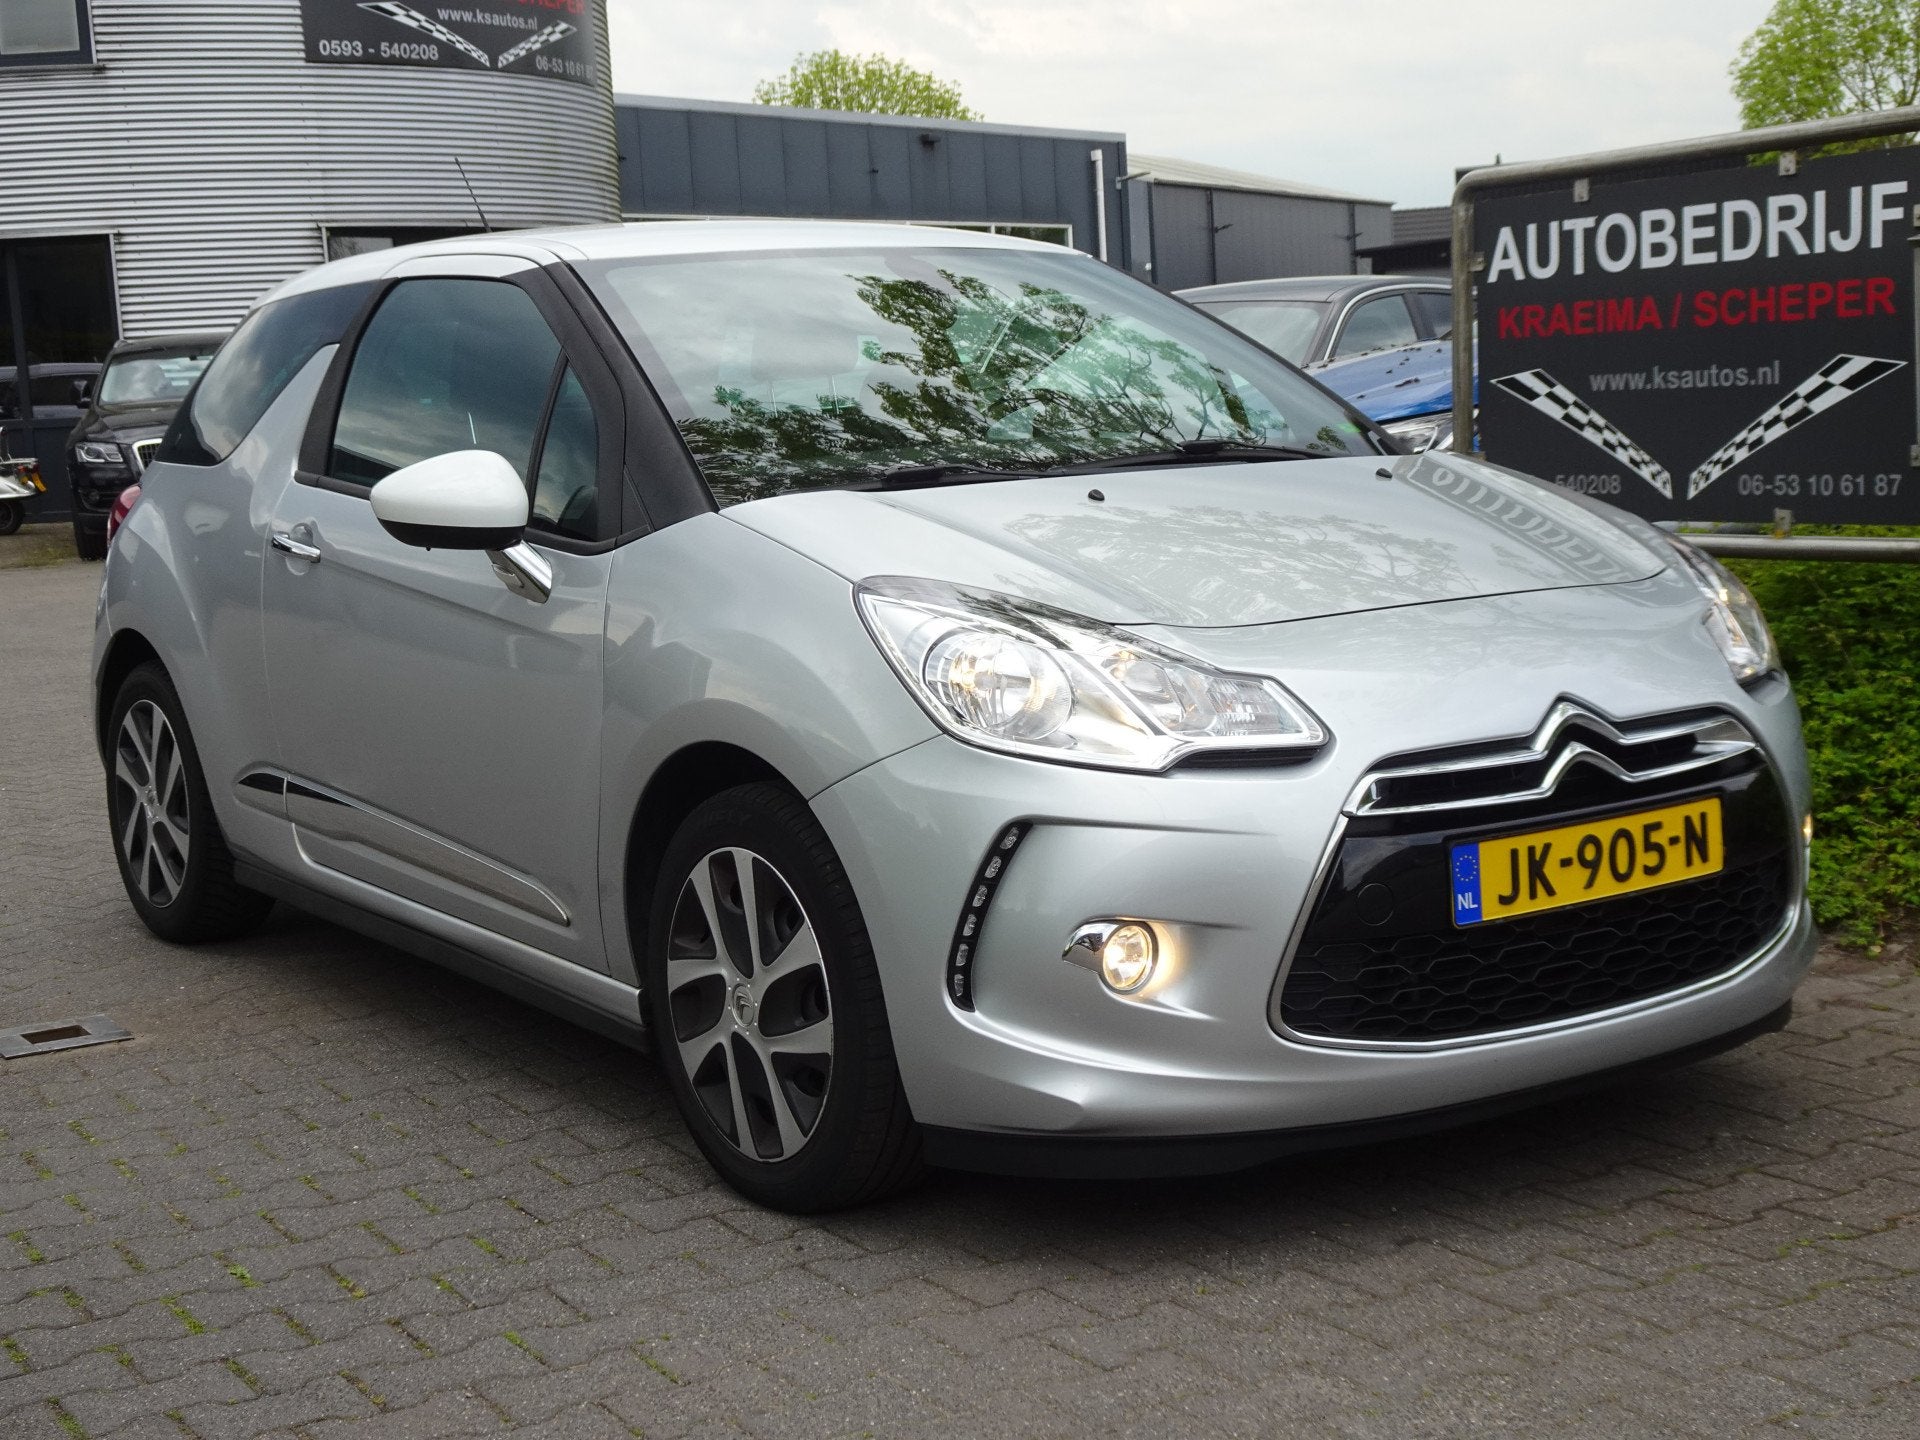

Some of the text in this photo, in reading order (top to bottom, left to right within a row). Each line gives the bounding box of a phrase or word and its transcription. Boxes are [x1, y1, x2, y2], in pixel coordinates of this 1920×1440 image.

[437, 8, 538, 30] www.ksautos.nl
[319, 39, 363, 57] 0593
[380, 41, 439, 60] 540208
[1487, 181, 1908, 283] AUTOBEDRIJF
[1499, 276, 1897, 339] KRAEIMA / SCHEPER
[1589, 360, 1780, 391] www.ksautos.nl
[1738, 474, 1902, 496] 06-53 10 61 87
[1498, 811, 1709, 906] JK-905-N
[1457, 892, 1478, 910] NL
